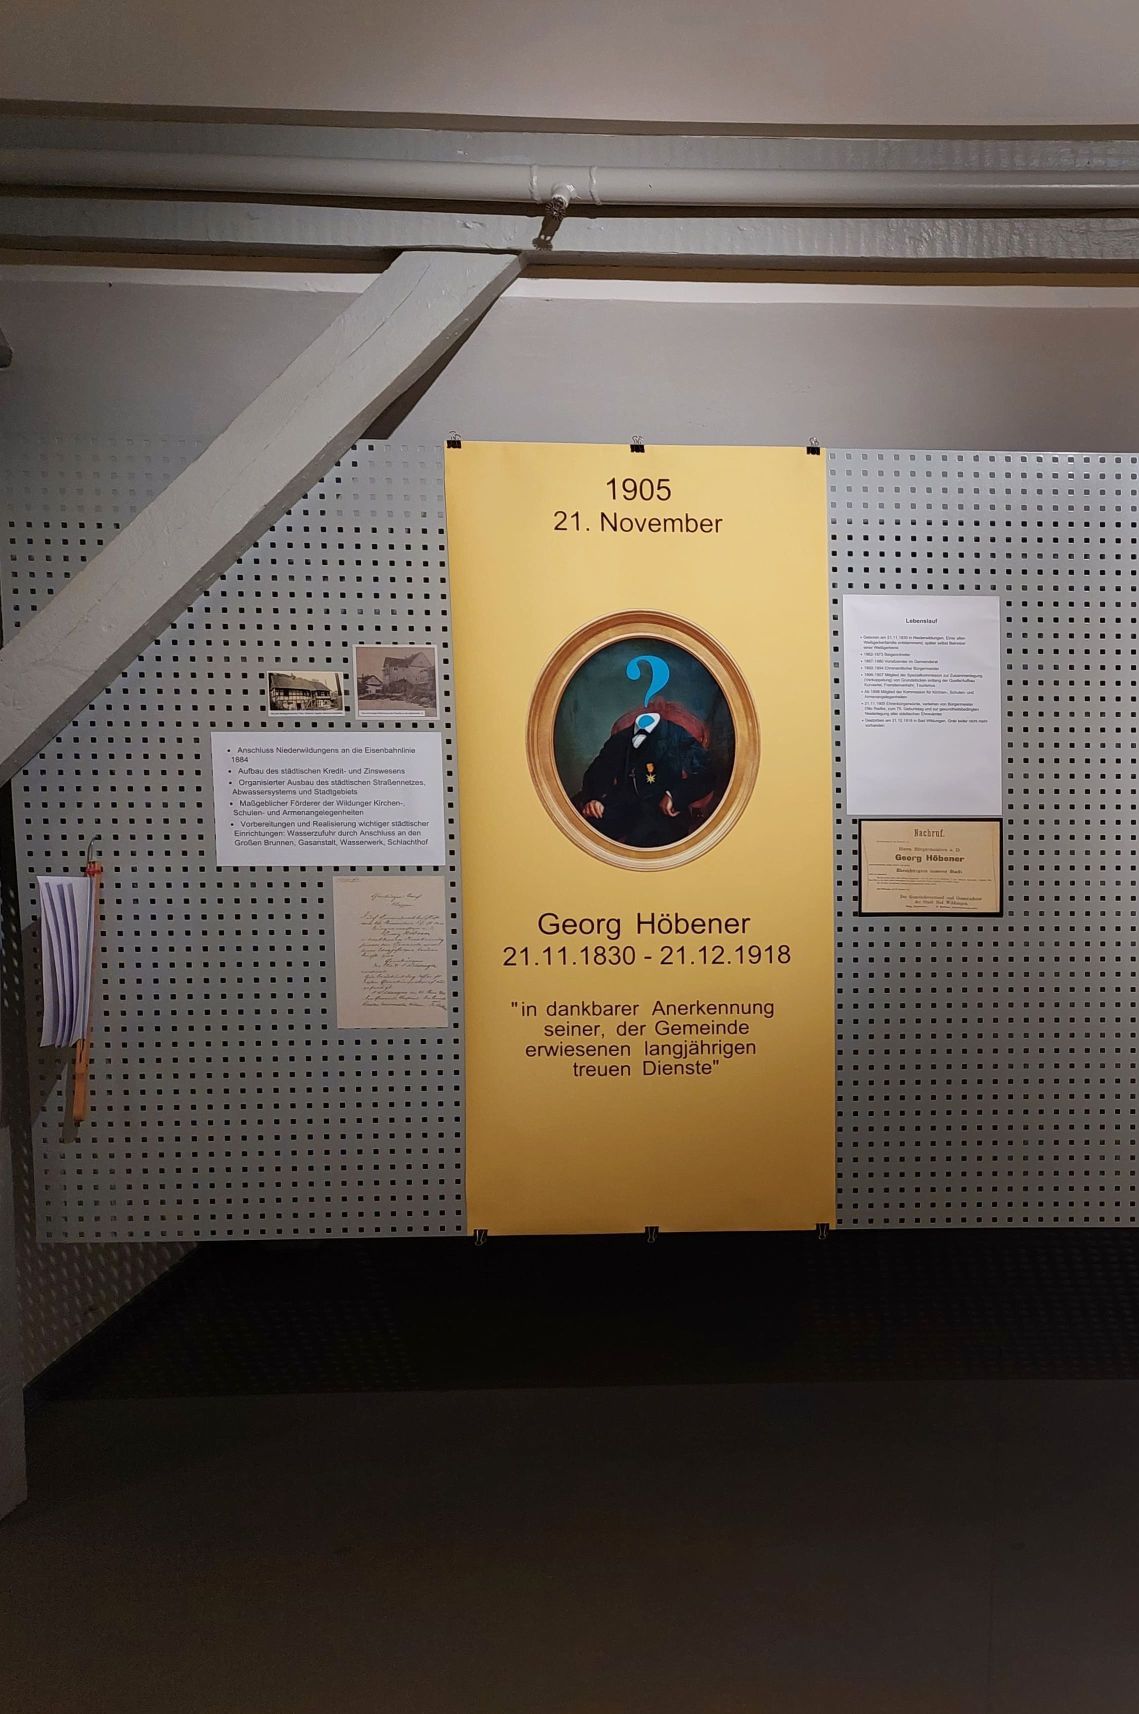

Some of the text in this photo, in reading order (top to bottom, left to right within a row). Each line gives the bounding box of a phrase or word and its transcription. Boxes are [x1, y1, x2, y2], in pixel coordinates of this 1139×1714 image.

[607, 478, 671, 501] 1905
[554, 511, 722, 533] 21. November
[276, 746, 339, 754] Niederwildungens
[232, 788, 296, 796] Abwassersystems
[239, 779, 285, 787] Organisierter
[240, 820, 295, 828] Vorbereitungen
[313, 820, 357, 828] Realisierung
[895, 854, 922, 862] Georg
[538, 913, 750, 940] Georg Höbener
[504, 946, 635, 966] 21.11.1830
[660, 945, 790, 964] 21.12.1918
[546, 1001, 639, 1016] dankbarer
[652, 1000, 774, 1018] Anerkennung
[544, 1020, 749, 1038] seiner, der Gemeinde
[526, 1040, 756, 1059] erwiesenen langjährigen
[573, 1058, 719, 1076] treuen Dienste"
